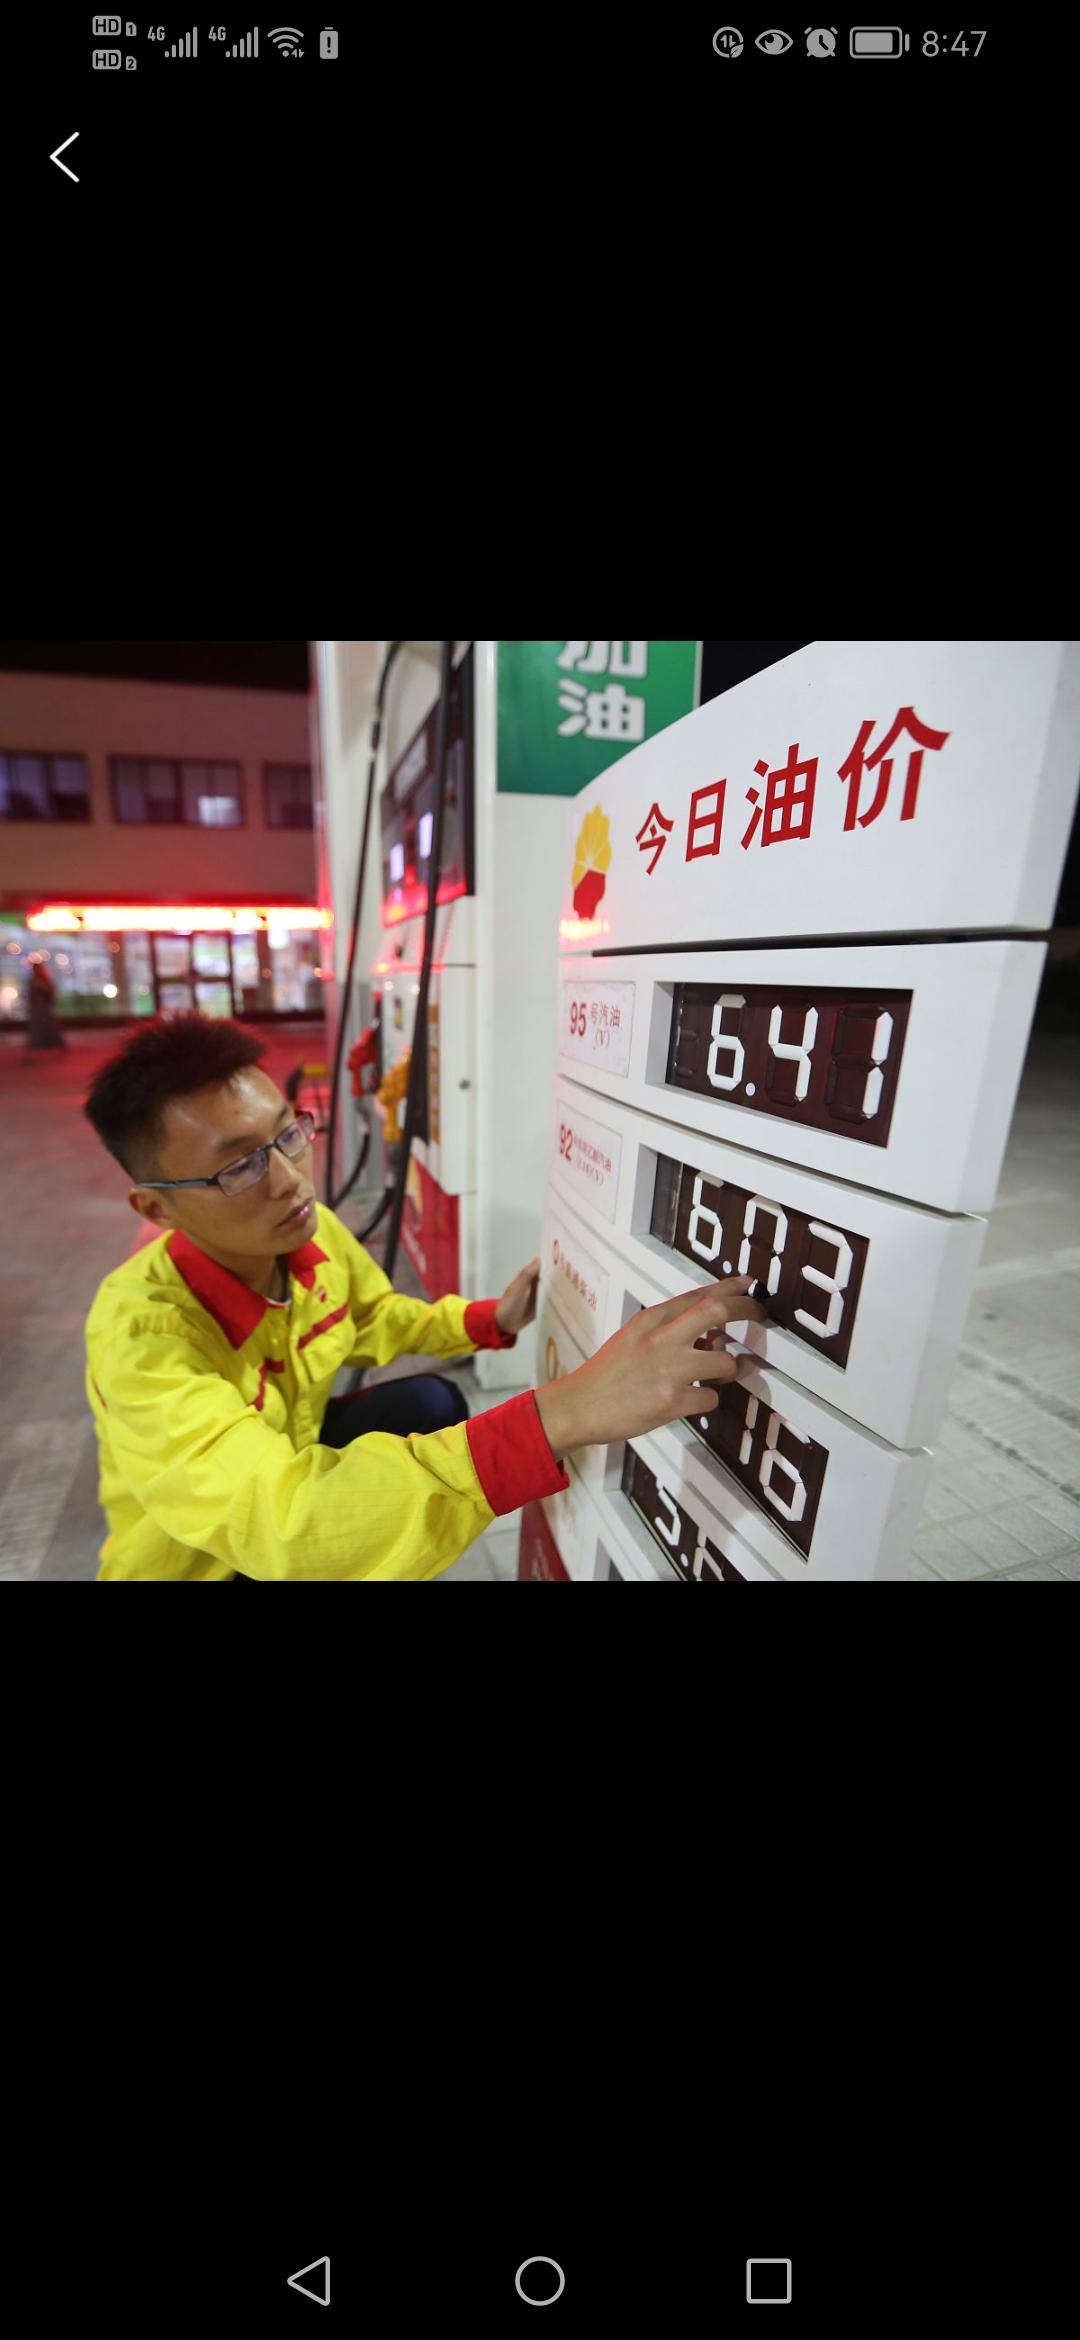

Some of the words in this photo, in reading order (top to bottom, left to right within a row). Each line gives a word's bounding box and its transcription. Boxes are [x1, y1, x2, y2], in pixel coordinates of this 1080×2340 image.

[636, 706, 950, 875] 今日油价
[707, 994, 894, 1119] 6.41
[688, 1171, 853, 1339] 6.03
[692, 1380, 808, 1522] .16
